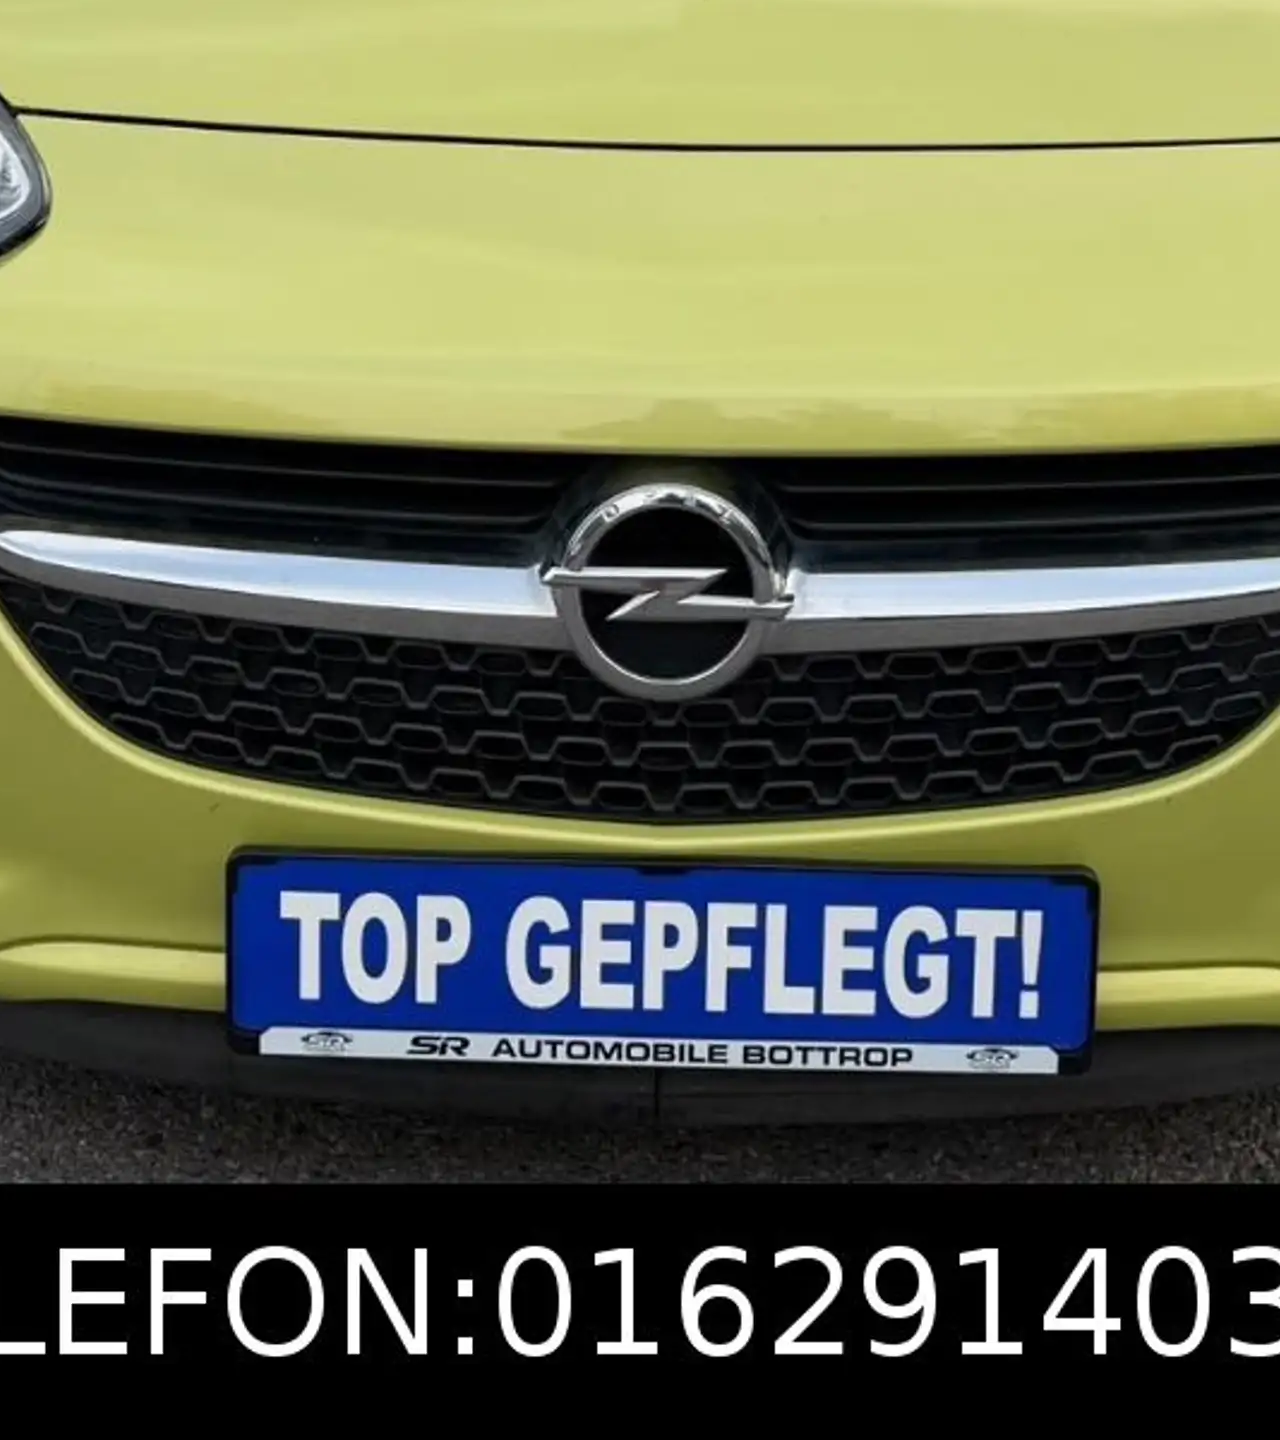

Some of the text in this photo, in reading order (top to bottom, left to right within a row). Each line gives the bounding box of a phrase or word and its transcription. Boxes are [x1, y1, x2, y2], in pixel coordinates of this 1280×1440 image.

[280, 891, 1043, 1018] TOP GEPFLEGT!
[406, 1035, 913, 1067] SR AUTOMOBILE BOTTROP
